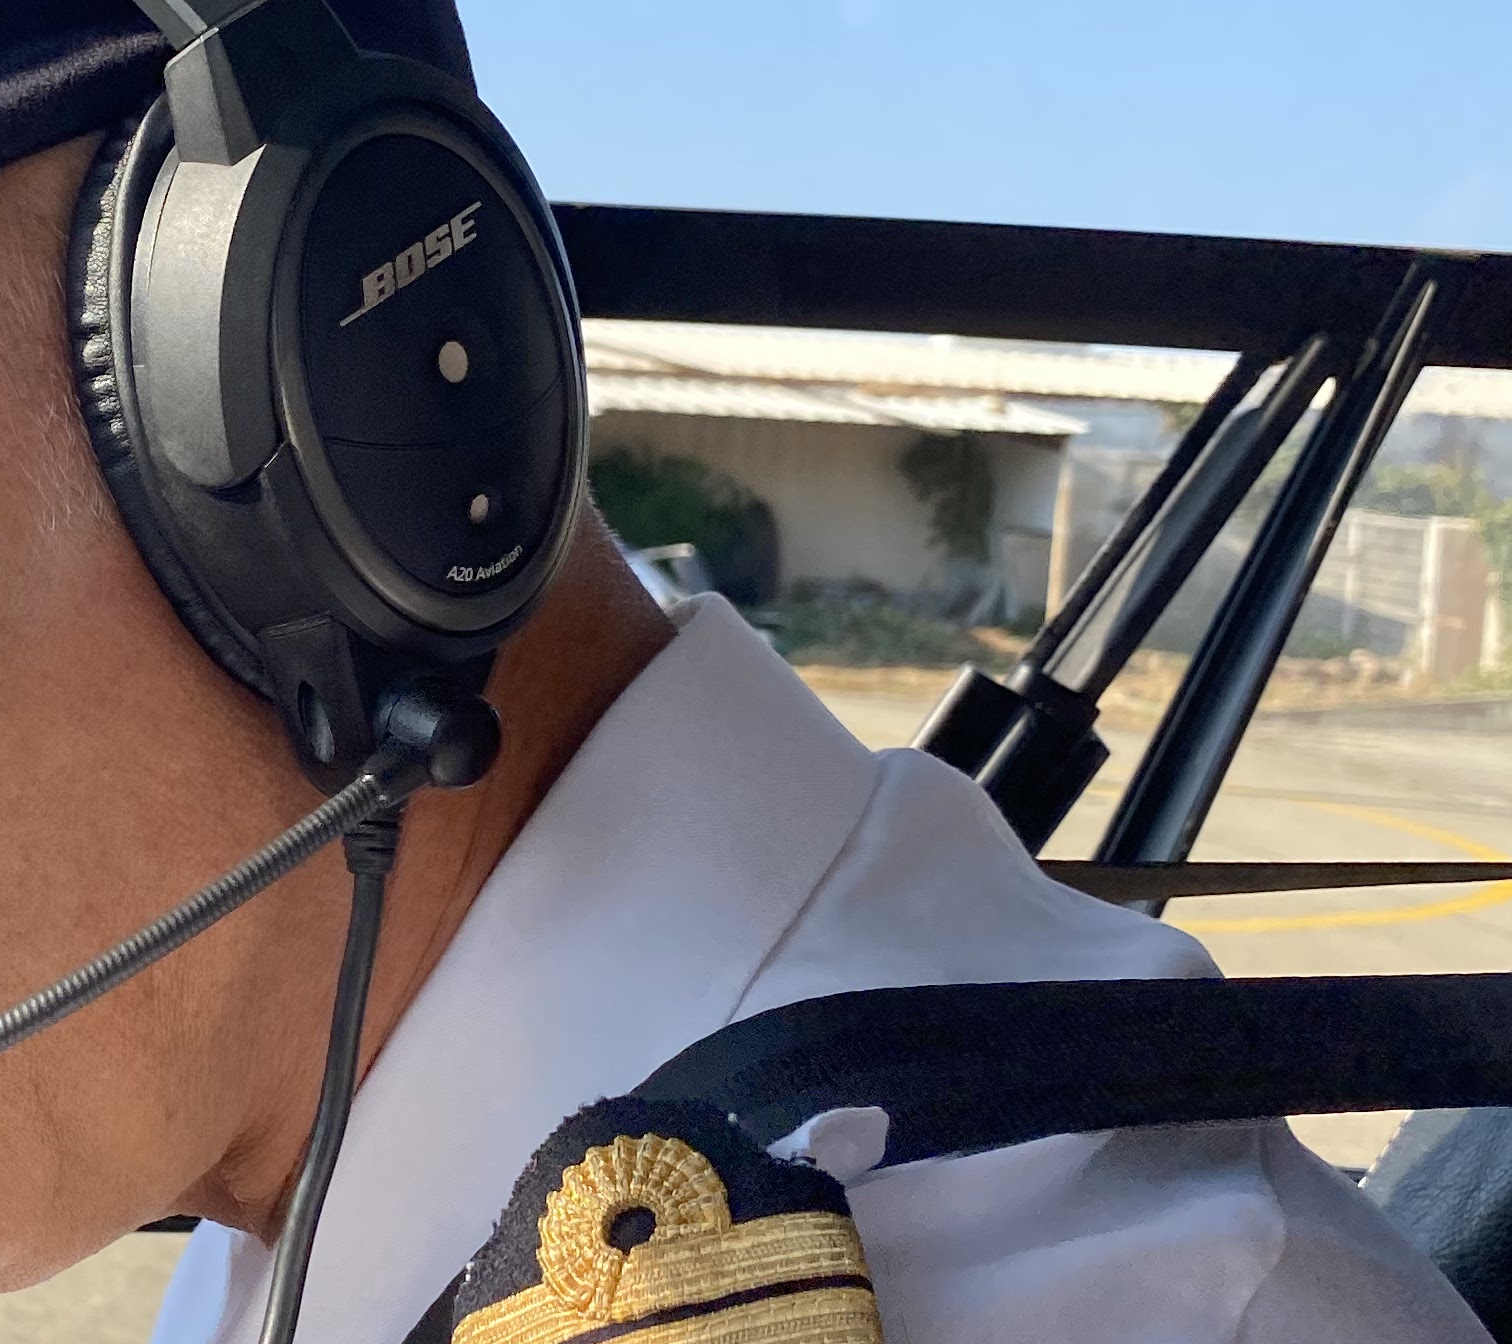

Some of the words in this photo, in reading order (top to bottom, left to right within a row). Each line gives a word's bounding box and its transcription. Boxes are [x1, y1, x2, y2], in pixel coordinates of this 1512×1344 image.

[339, 200, 482, 327] BOSE
[446, 565, 474, 583] A20
[476, 544, 524, 582] Aviation
